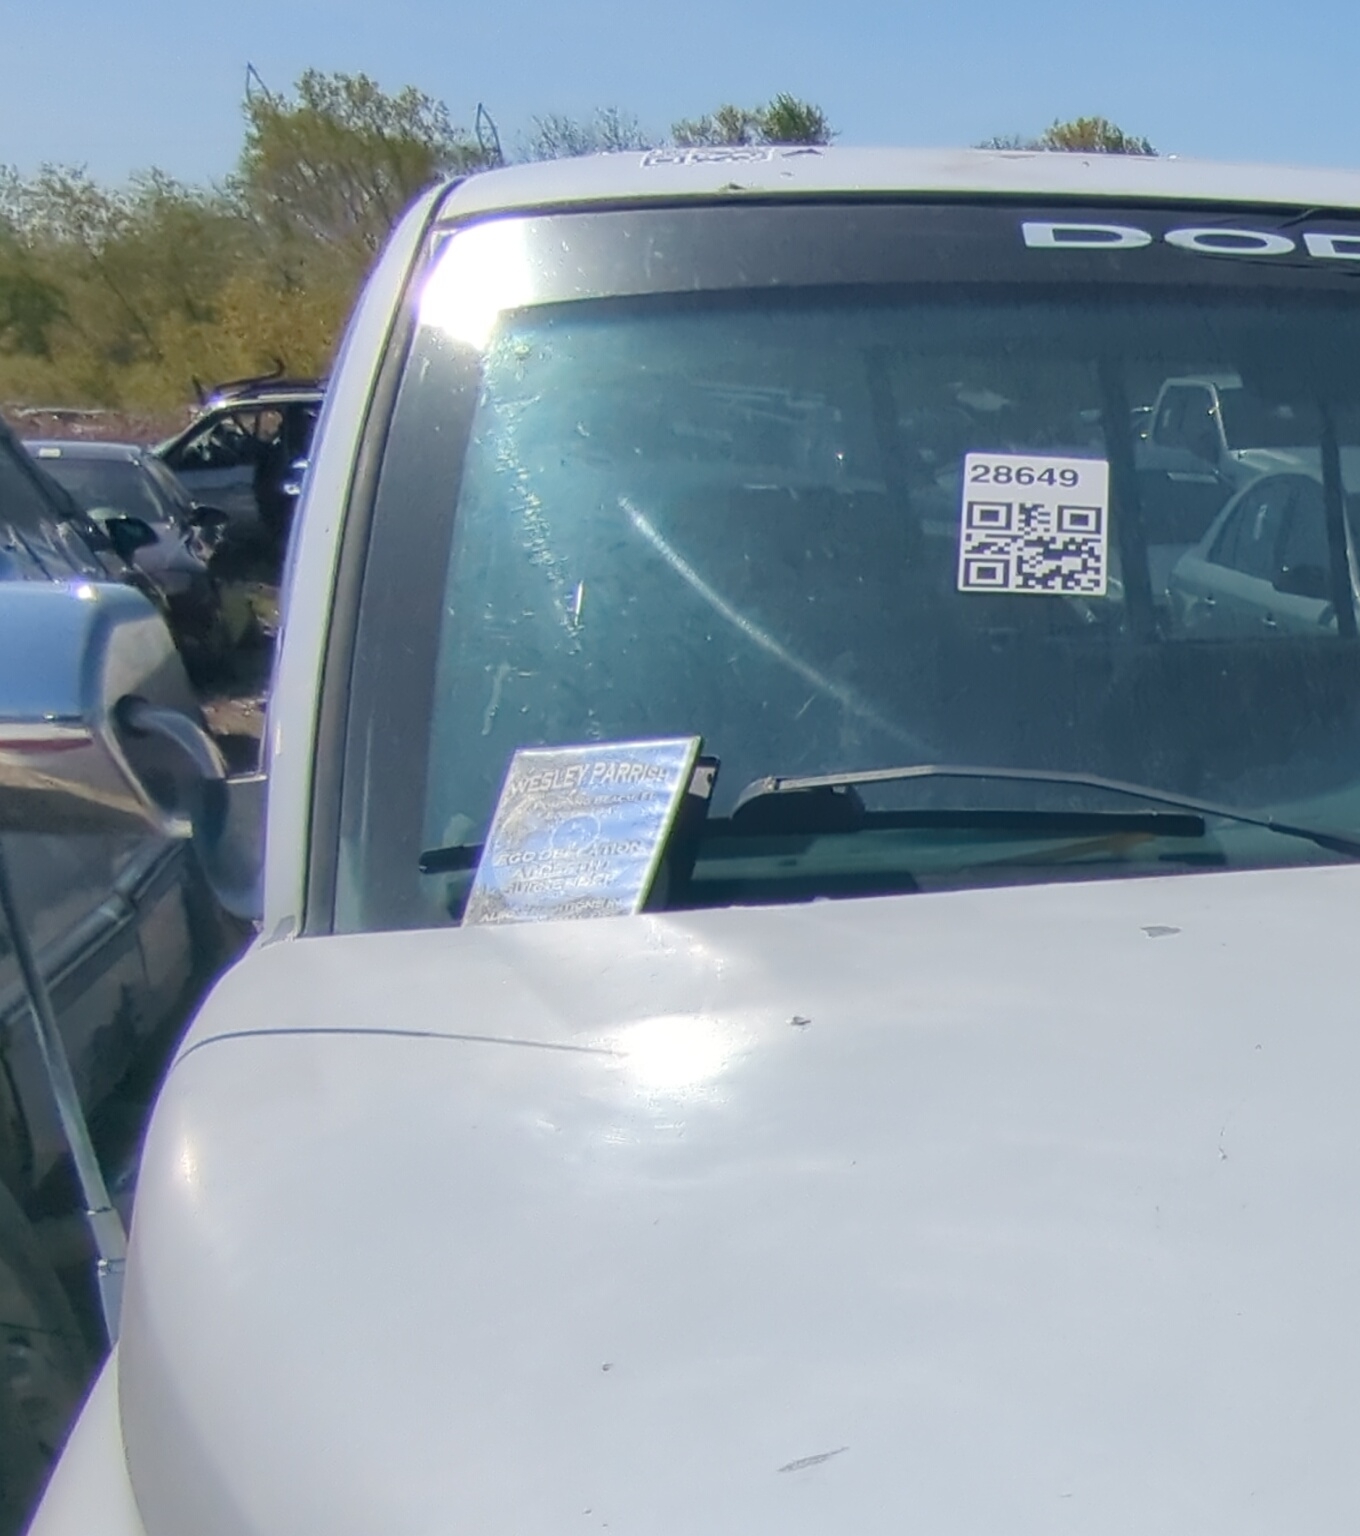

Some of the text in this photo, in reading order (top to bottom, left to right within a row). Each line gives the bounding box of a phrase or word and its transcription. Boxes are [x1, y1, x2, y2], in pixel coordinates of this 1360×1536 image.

[970, 464, 1080, 488] 28649
[510, 761, 669, 796] WESLEY PARRISH
